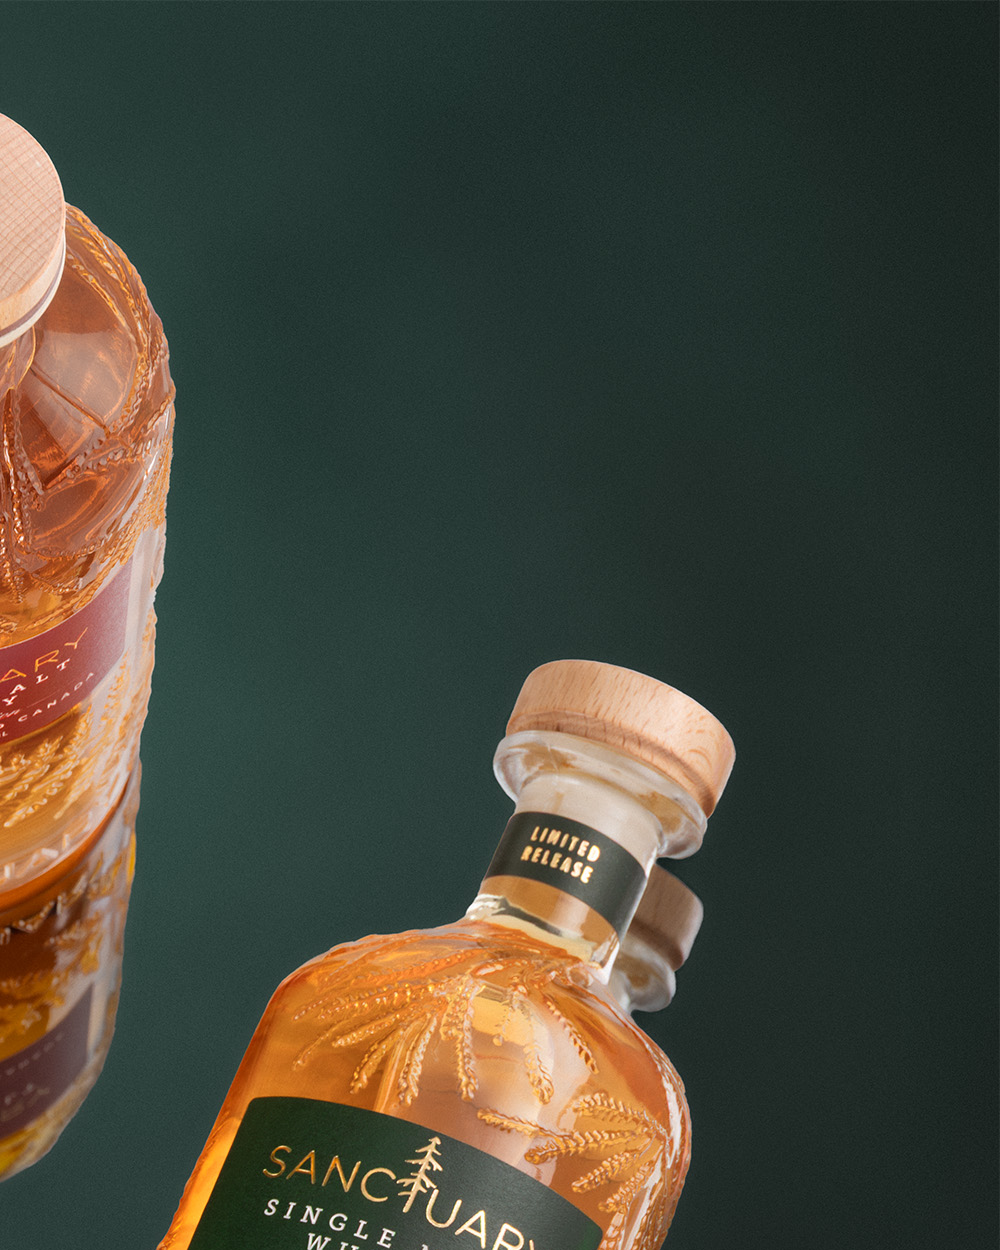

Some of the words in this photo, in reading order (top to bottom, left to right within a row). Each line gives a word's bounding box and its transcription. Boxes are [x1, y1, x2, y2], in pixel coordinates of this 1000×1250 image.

[17, 672, 95, 723] CANADA
[520, 845, 594, 884] RELEASE
[530, 825, 601, 863] LIMITED
[263, 1198, 397, 1250] SINGLE
